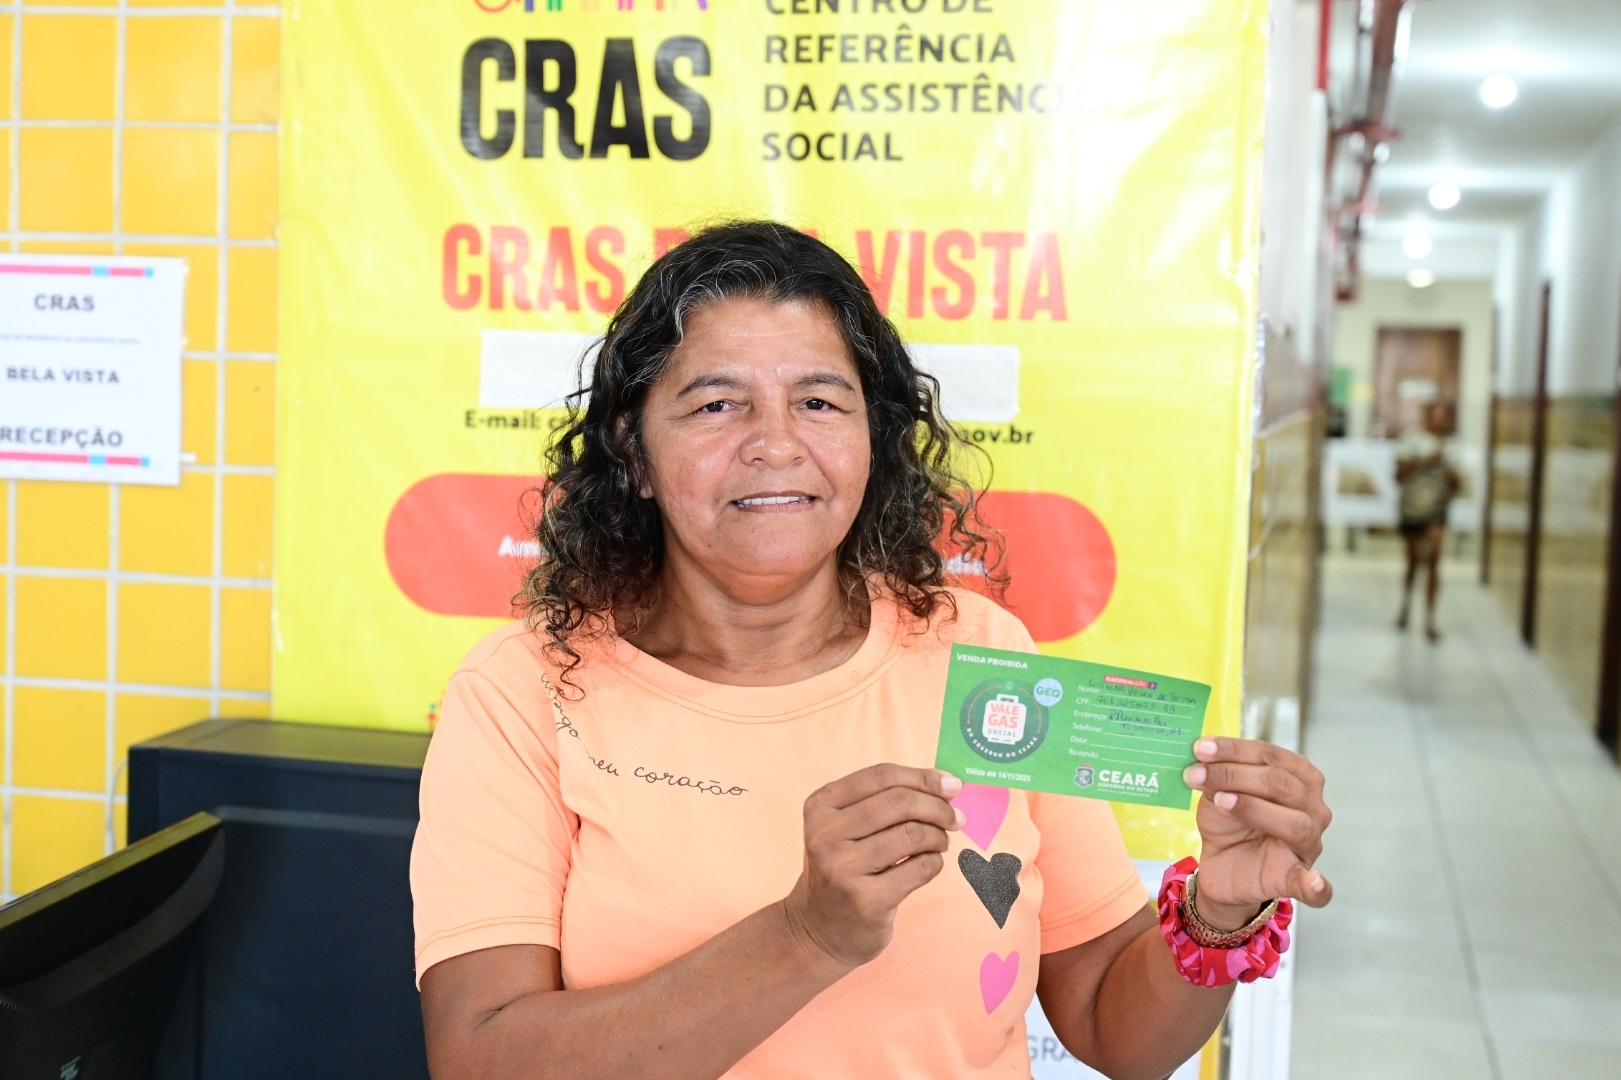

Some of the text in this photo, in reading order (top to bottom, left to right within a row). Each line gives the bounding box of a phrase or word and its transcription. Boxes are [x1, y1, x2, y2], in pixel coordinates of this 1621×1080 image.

[764, 22, 1016, 63] REFERÊNCIA
[459, 35, 712, 162] CRAS
[763, 83, 817, 113] DA
[762, 132, 904, 162] SOCIAL
[441, 222, 627, 314] CRAS
[855, 229, 1068, 322] VISTA
[33, 294, 96, 312] CRAS
[6, 367, 120, 384] BELA VISTA
[465, 409, 541, 428] E-mail:
[0, 425, 124, 449] RECEPÇÃO
[957, 653, 1028, 669] VENDA PROIBIDA
[990, 703, 1020, 716] VALE
[987, 728, 1017, 738] SOCIAL
[1072, 722, 1103, 733] Telefone:
[973, 738, 1003, 758] GOVERNO
[1070, 735, 1089, 744] Data:
[1068, 748, 1099, 759] Revenda:
[634, 766, 749, 796] coração
[965, 767, 986, 777] Válido
[986, 769, 997, 778] até
[1098, 769, 1160, 789] CEARÁ
[1097, 782, 1126, 790] GOVERNO
[1136, 786, 1159, 794] ESTADO
